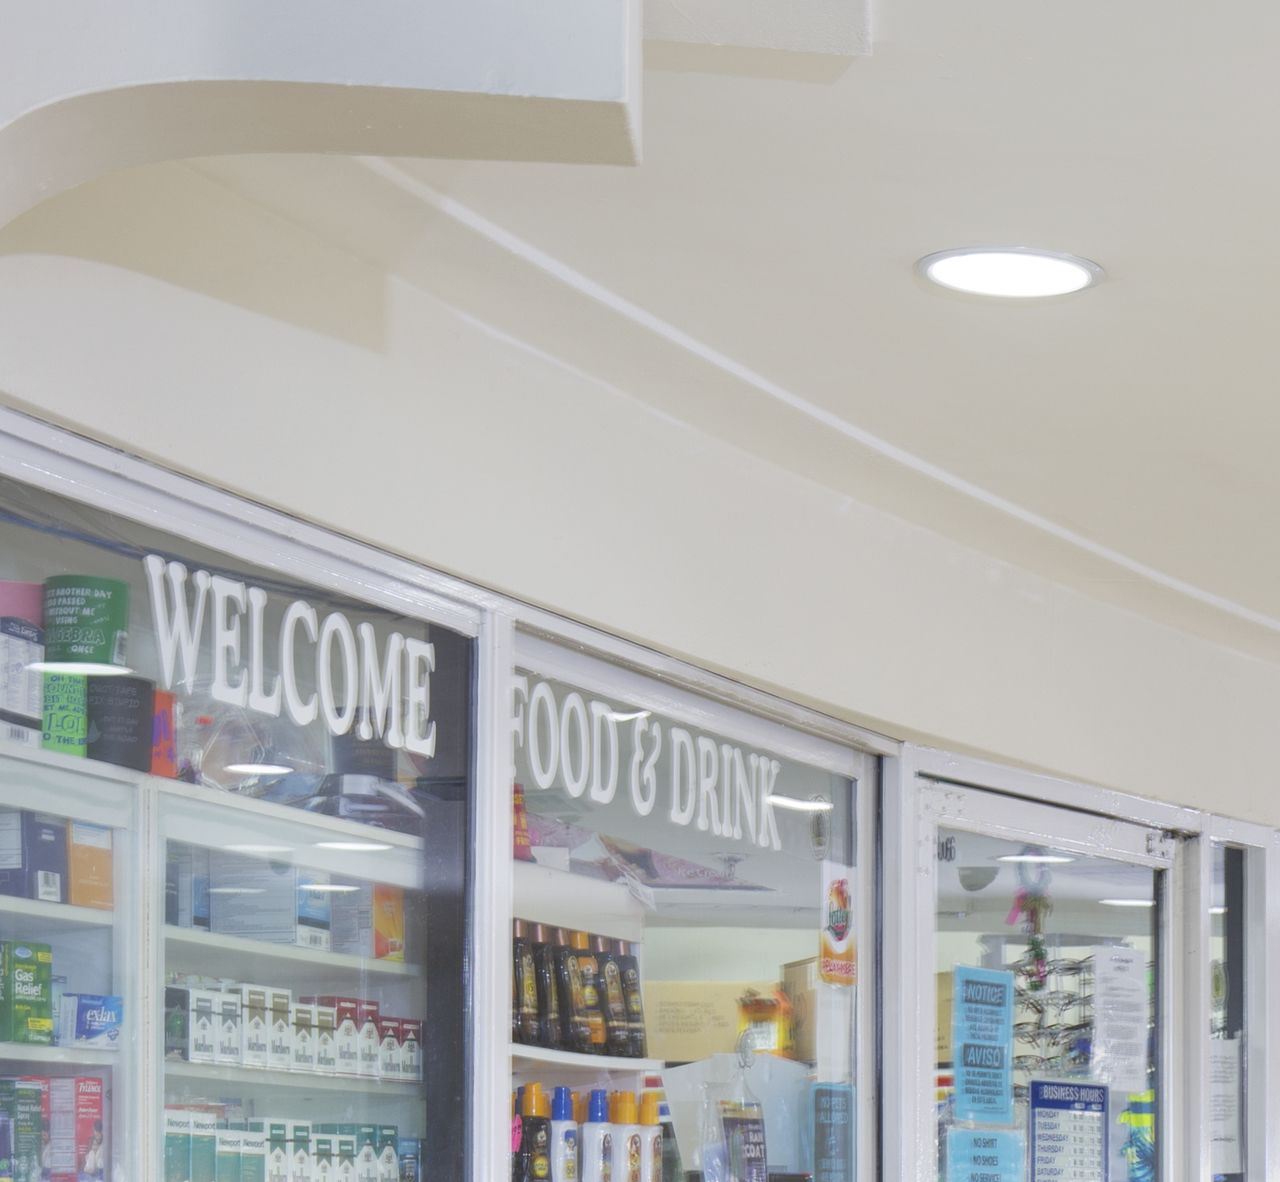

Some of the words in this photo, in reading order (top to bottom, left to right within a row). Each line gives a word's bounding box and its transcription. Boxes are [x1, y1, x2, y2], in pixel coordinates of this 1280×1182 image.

[143, 553, 438, 759] WELCOME
[512, 675, 619, 804] FOOD
[631, 715, 662, 816] &
[670, 727, 782, 850] DRINK
[15, 968, 34, 982] Gas
[15, 982, 42, 996] Relief
[967, 1046, 1001, 1067] AVISO
